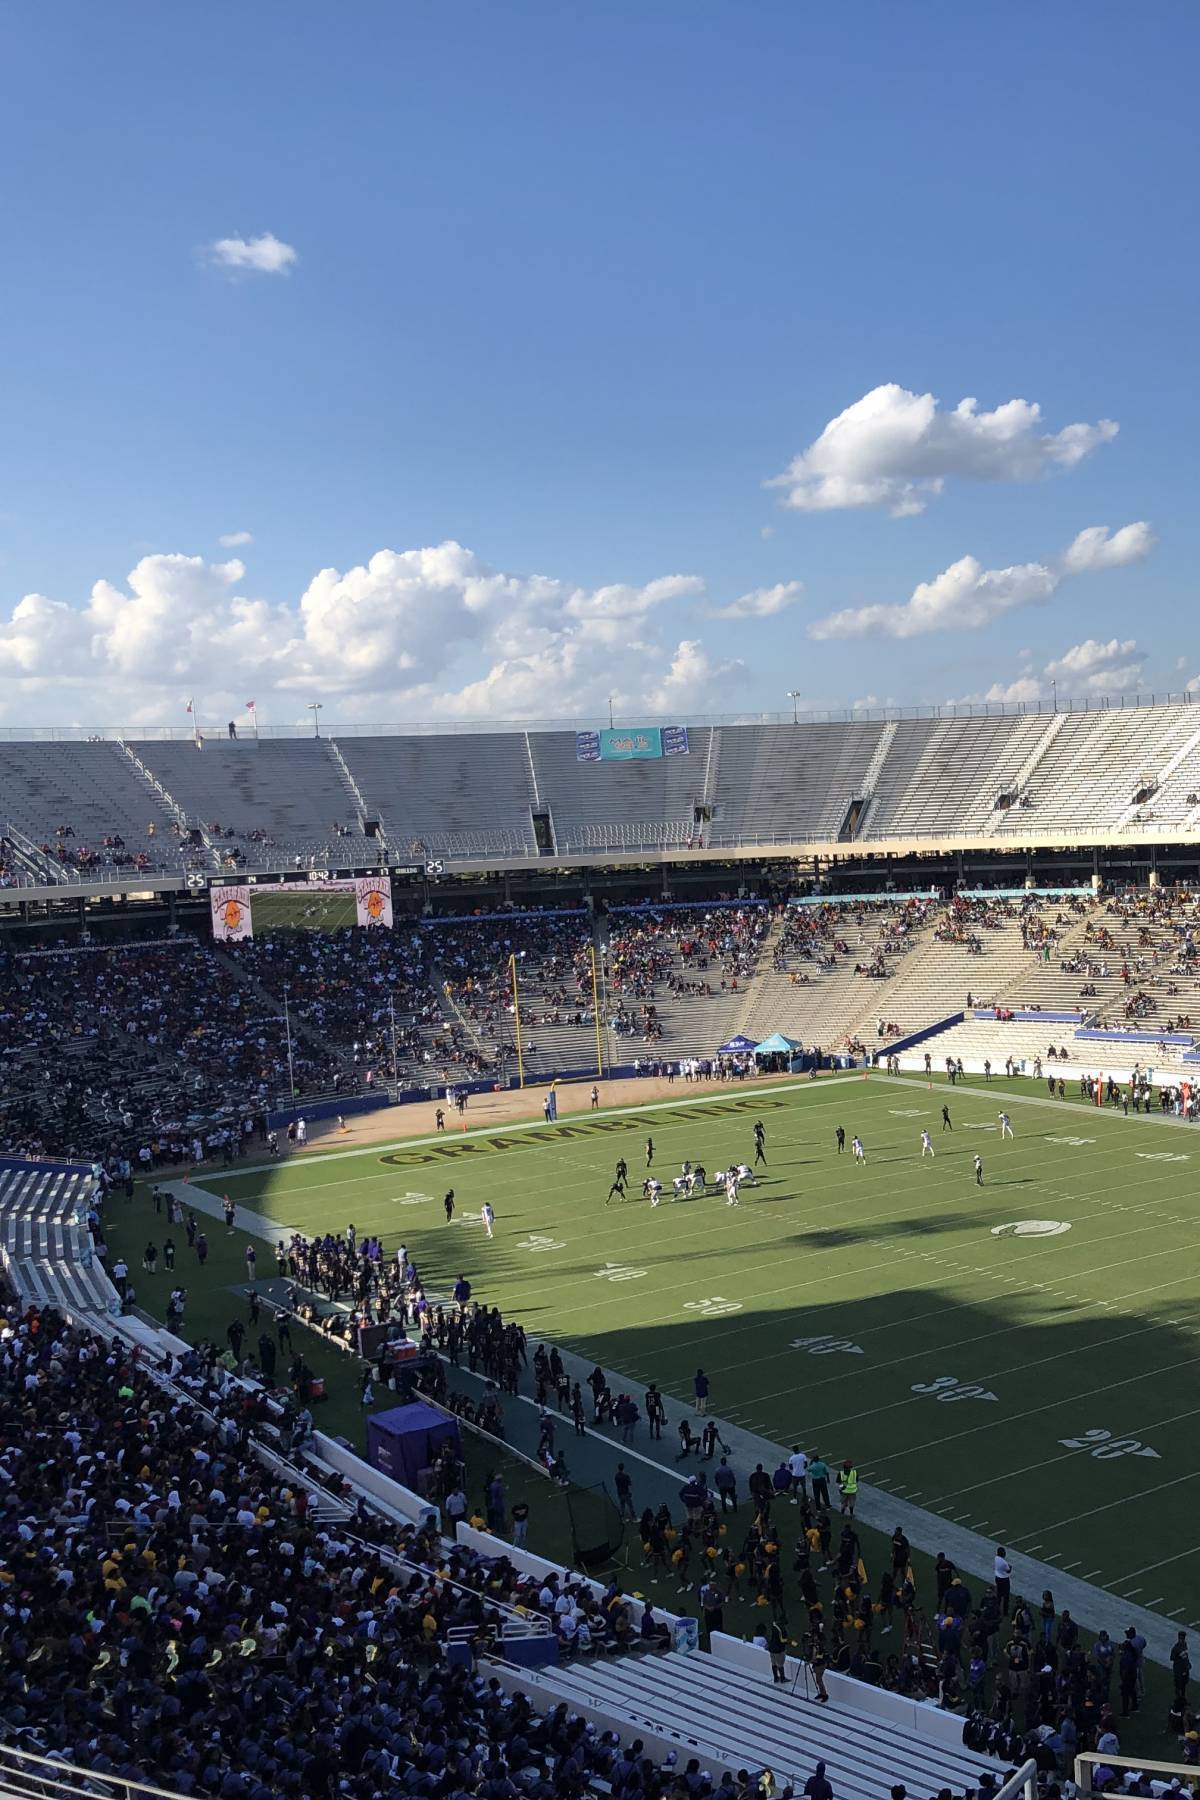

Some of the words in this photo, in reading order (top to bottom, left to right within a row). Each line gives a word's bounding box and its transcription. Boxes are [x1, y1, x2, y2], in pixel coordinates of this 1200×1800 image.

[380, 868, 389, 876] 17
[427, 861, 442, 873] 25
[187, 874, 205, 887] 25
[248, 876, 257, 884] 14
[308, 871, 329, 881] 10:42
[378, 1099, 788, 1165] GRAMBLING
[683, 1296, 744, 1315] 50
[788, 1335, 853, 1354] 40
[558, 1378, 568, 1387] 39
[910, 1376, 984, 1402] 30
[1057, 1429, 1144, 1459] 20
